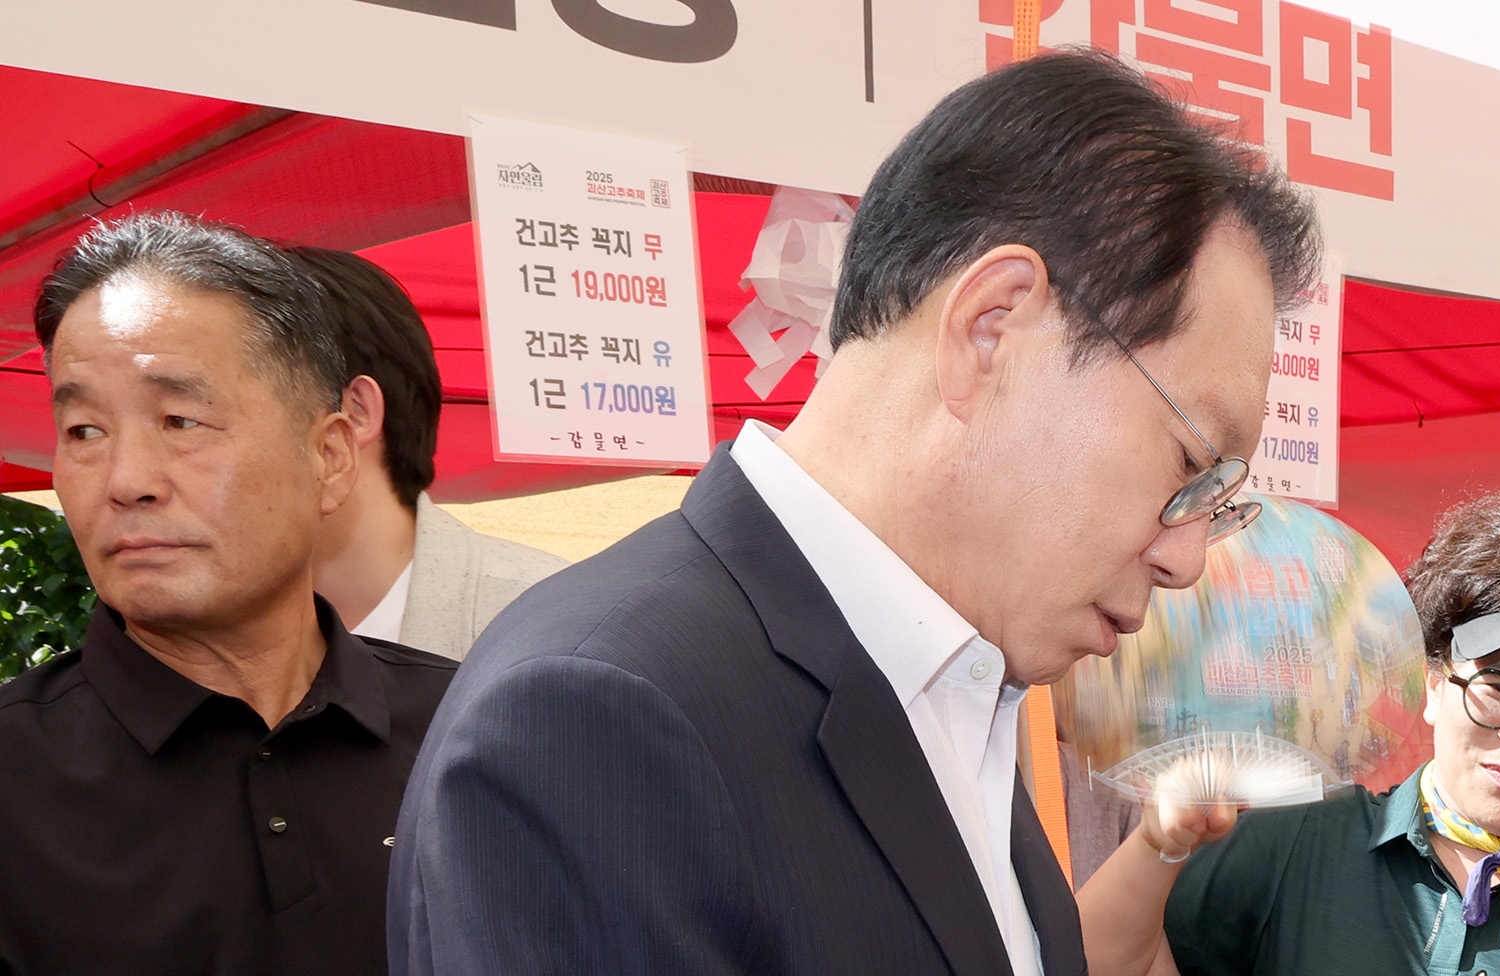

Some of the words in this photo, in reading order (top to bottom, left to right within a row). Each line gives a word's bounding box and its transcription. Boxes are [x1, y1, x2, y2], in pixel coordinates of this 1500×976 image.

[497, 169, 543, 187] 자연울림
[586, 170, 613, 184] 2025
[587, 183, 646, 200] 괴산고추축제
[516, 218, 580, 251] 건고추
[591, 227, 632, 258] 꼭지
[644, 233, 663, 261] 무
[519, 264, 556, 297] 1근
[571, 269, 668, 308] 19,000원
[1279, 318, 1303, 342] 꼭지
[1309, 324, 1320, 345] 무
[525, 330, 589, 361] 건고추
[601, 336, 641, 365] 꼭지
[652, 340, 672, 367] 유
[1271, 352, 1319, 381] 9,000원
[529, 378, 567, 410] 1근
[580, 382, 677, 416] 17,000원
[1277, 402, 1300, 425] 꼭지
[1307, 406, 1319, 428] 유
[1262, 436, 1319, 465] 17,000원
[1264, 645, 1313, 664] 2025
[1206, 662, 1313, 686] 괴산고추축제
[1237, 688, 1252, 696] RED
